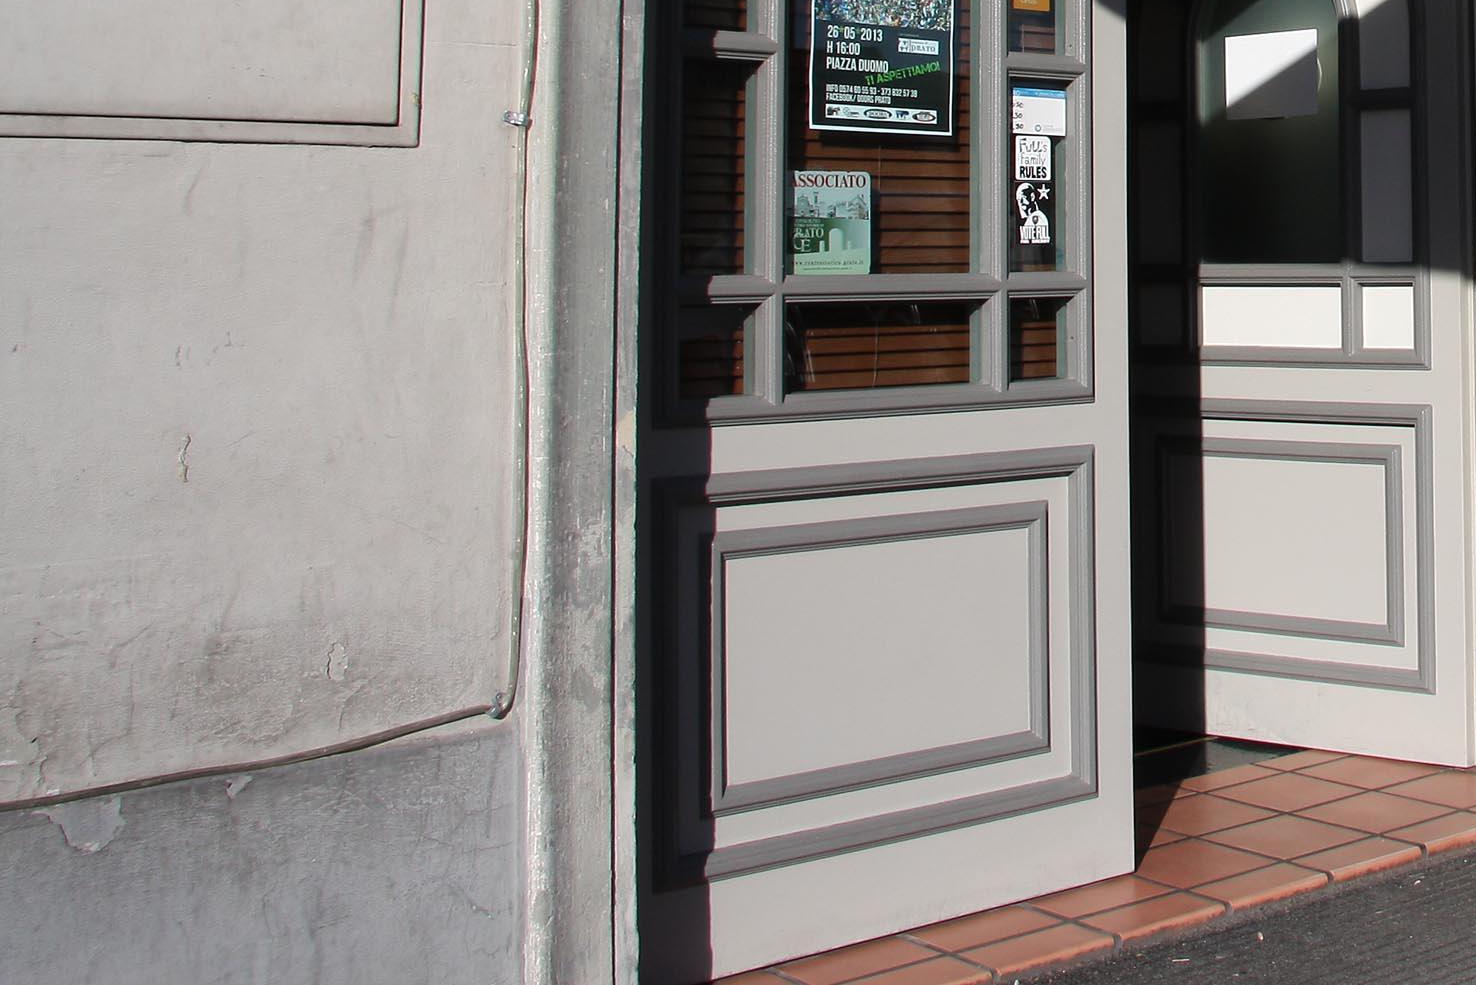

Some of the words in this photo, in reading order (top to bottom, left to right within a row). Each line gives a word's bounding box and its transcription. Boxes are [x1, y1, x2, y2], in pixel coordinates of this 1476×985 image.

[827, 25, 839, 38] 26
[844, 26, 856, 39] 05
[860, 28, 883, 42] 2013
[826, 41, 834, 54] H
[836, 42, 860, 56] 16:00
[826, 57, 857, 72] PIAZZA
[858, 59, 889, 74] DUOMO
[1019, 165, 1047, 179] RULES
[793, 227, 824, 239] RATO
